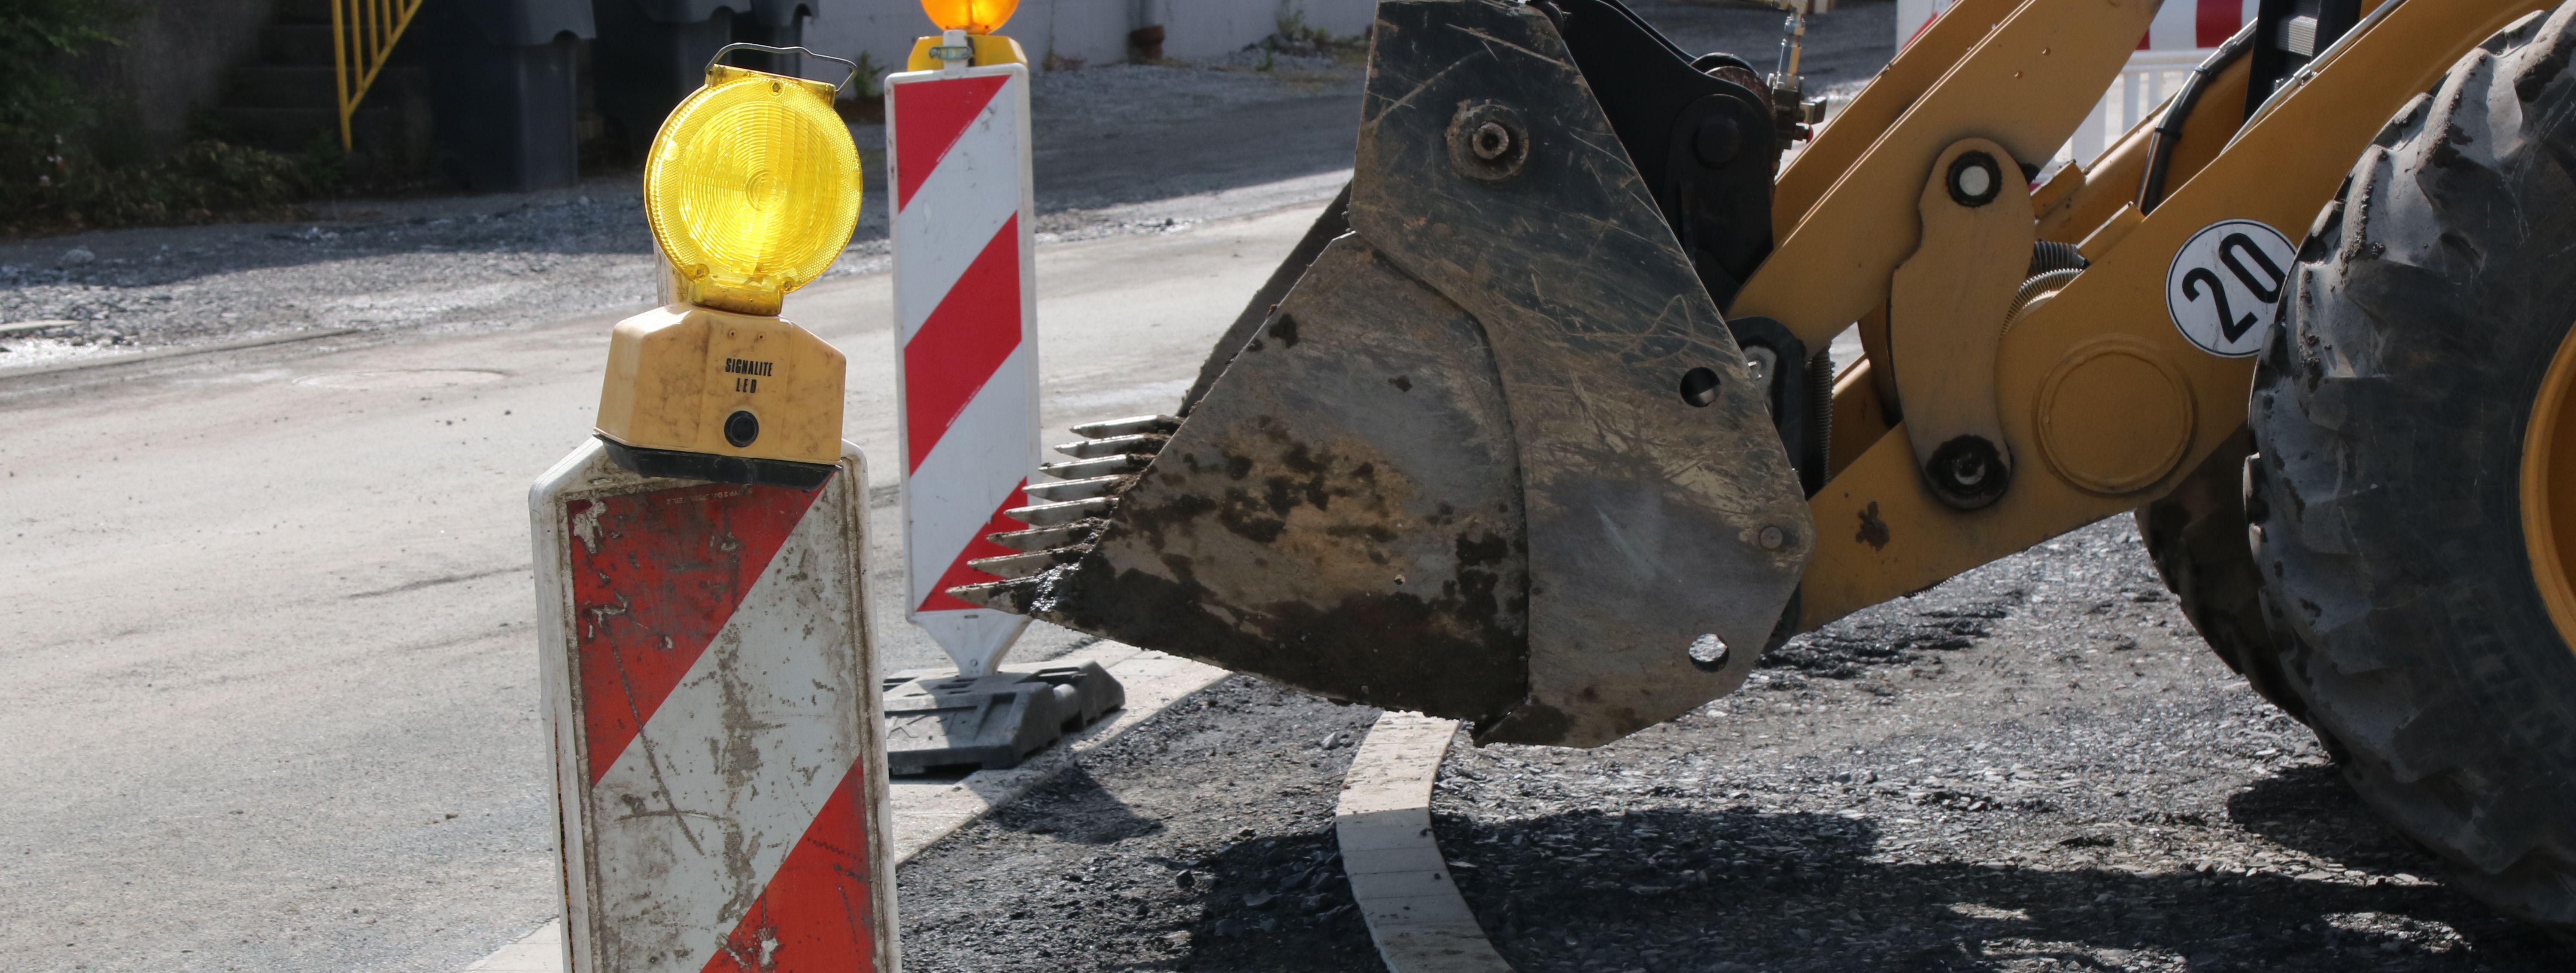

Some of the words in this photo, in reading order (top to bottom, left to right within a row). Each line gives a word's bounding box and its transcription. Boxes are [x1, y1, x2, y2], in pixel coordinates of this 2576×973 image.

[2182, 233, 2286, 344] 20
[726, 358, 773, 376] SIGNALITE
[736, 378, 757, 393] LED
